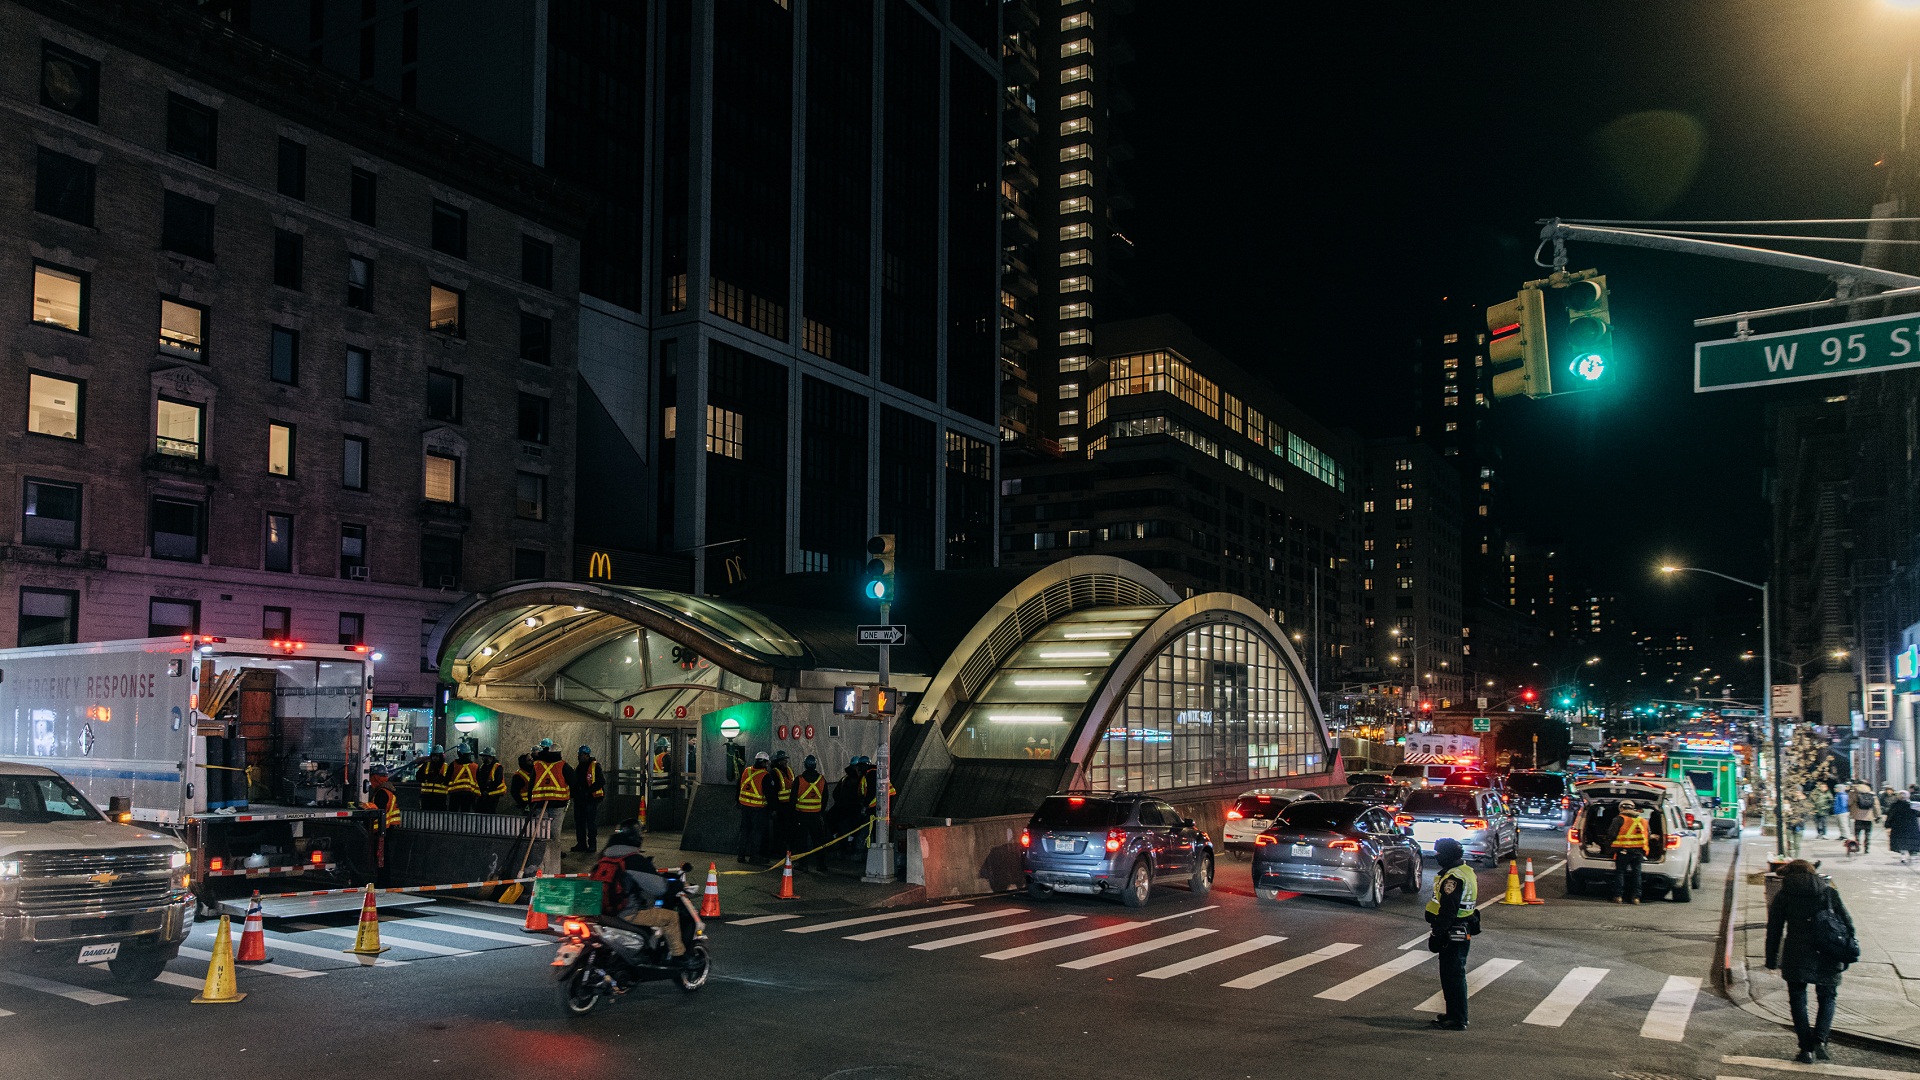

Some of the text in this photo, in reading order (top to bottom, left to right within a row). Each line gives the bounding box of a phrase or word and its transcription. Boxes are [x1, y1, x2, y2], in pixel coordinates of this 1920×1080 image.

[1764, 325, 1920, 373] W 95 S
[864, 631, 899, 639] ONE WAY
[12, 673, 156, 700] EMERGENCY RESPONSE
[626, 702, 684, 717] 1 2
[794, 727, 800, 738] 2
[807, 727, 813, 737] 3
[81, 947, 117, 957] DANELLA
